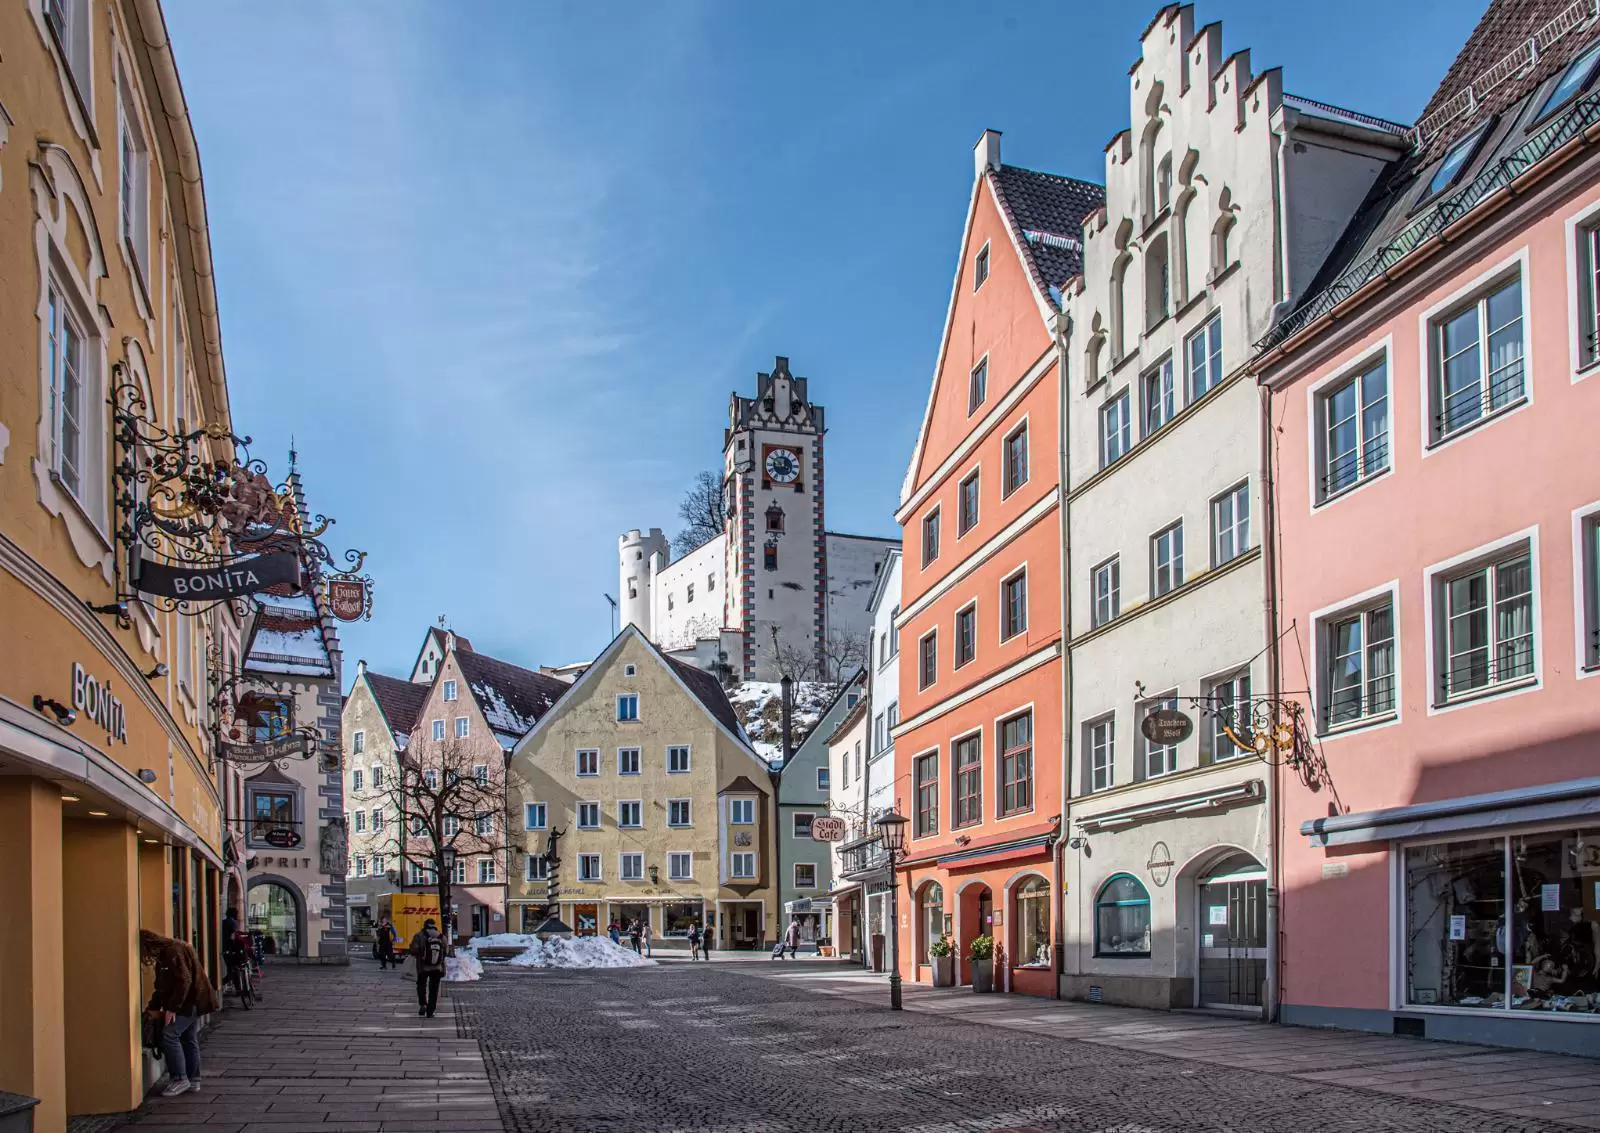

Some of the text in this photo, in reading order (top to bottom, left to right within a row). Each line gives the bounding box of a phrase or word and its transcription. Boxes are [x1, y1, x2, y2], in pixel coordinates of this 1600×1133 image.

[173, 568, 260, 594] BONITA
[72, 661, 128, 747] BONITA
[815, 820, 842, 830] Stadt
[255, 856, 311, 869] SPRIT
[402, 906, 440, 915] DHL
